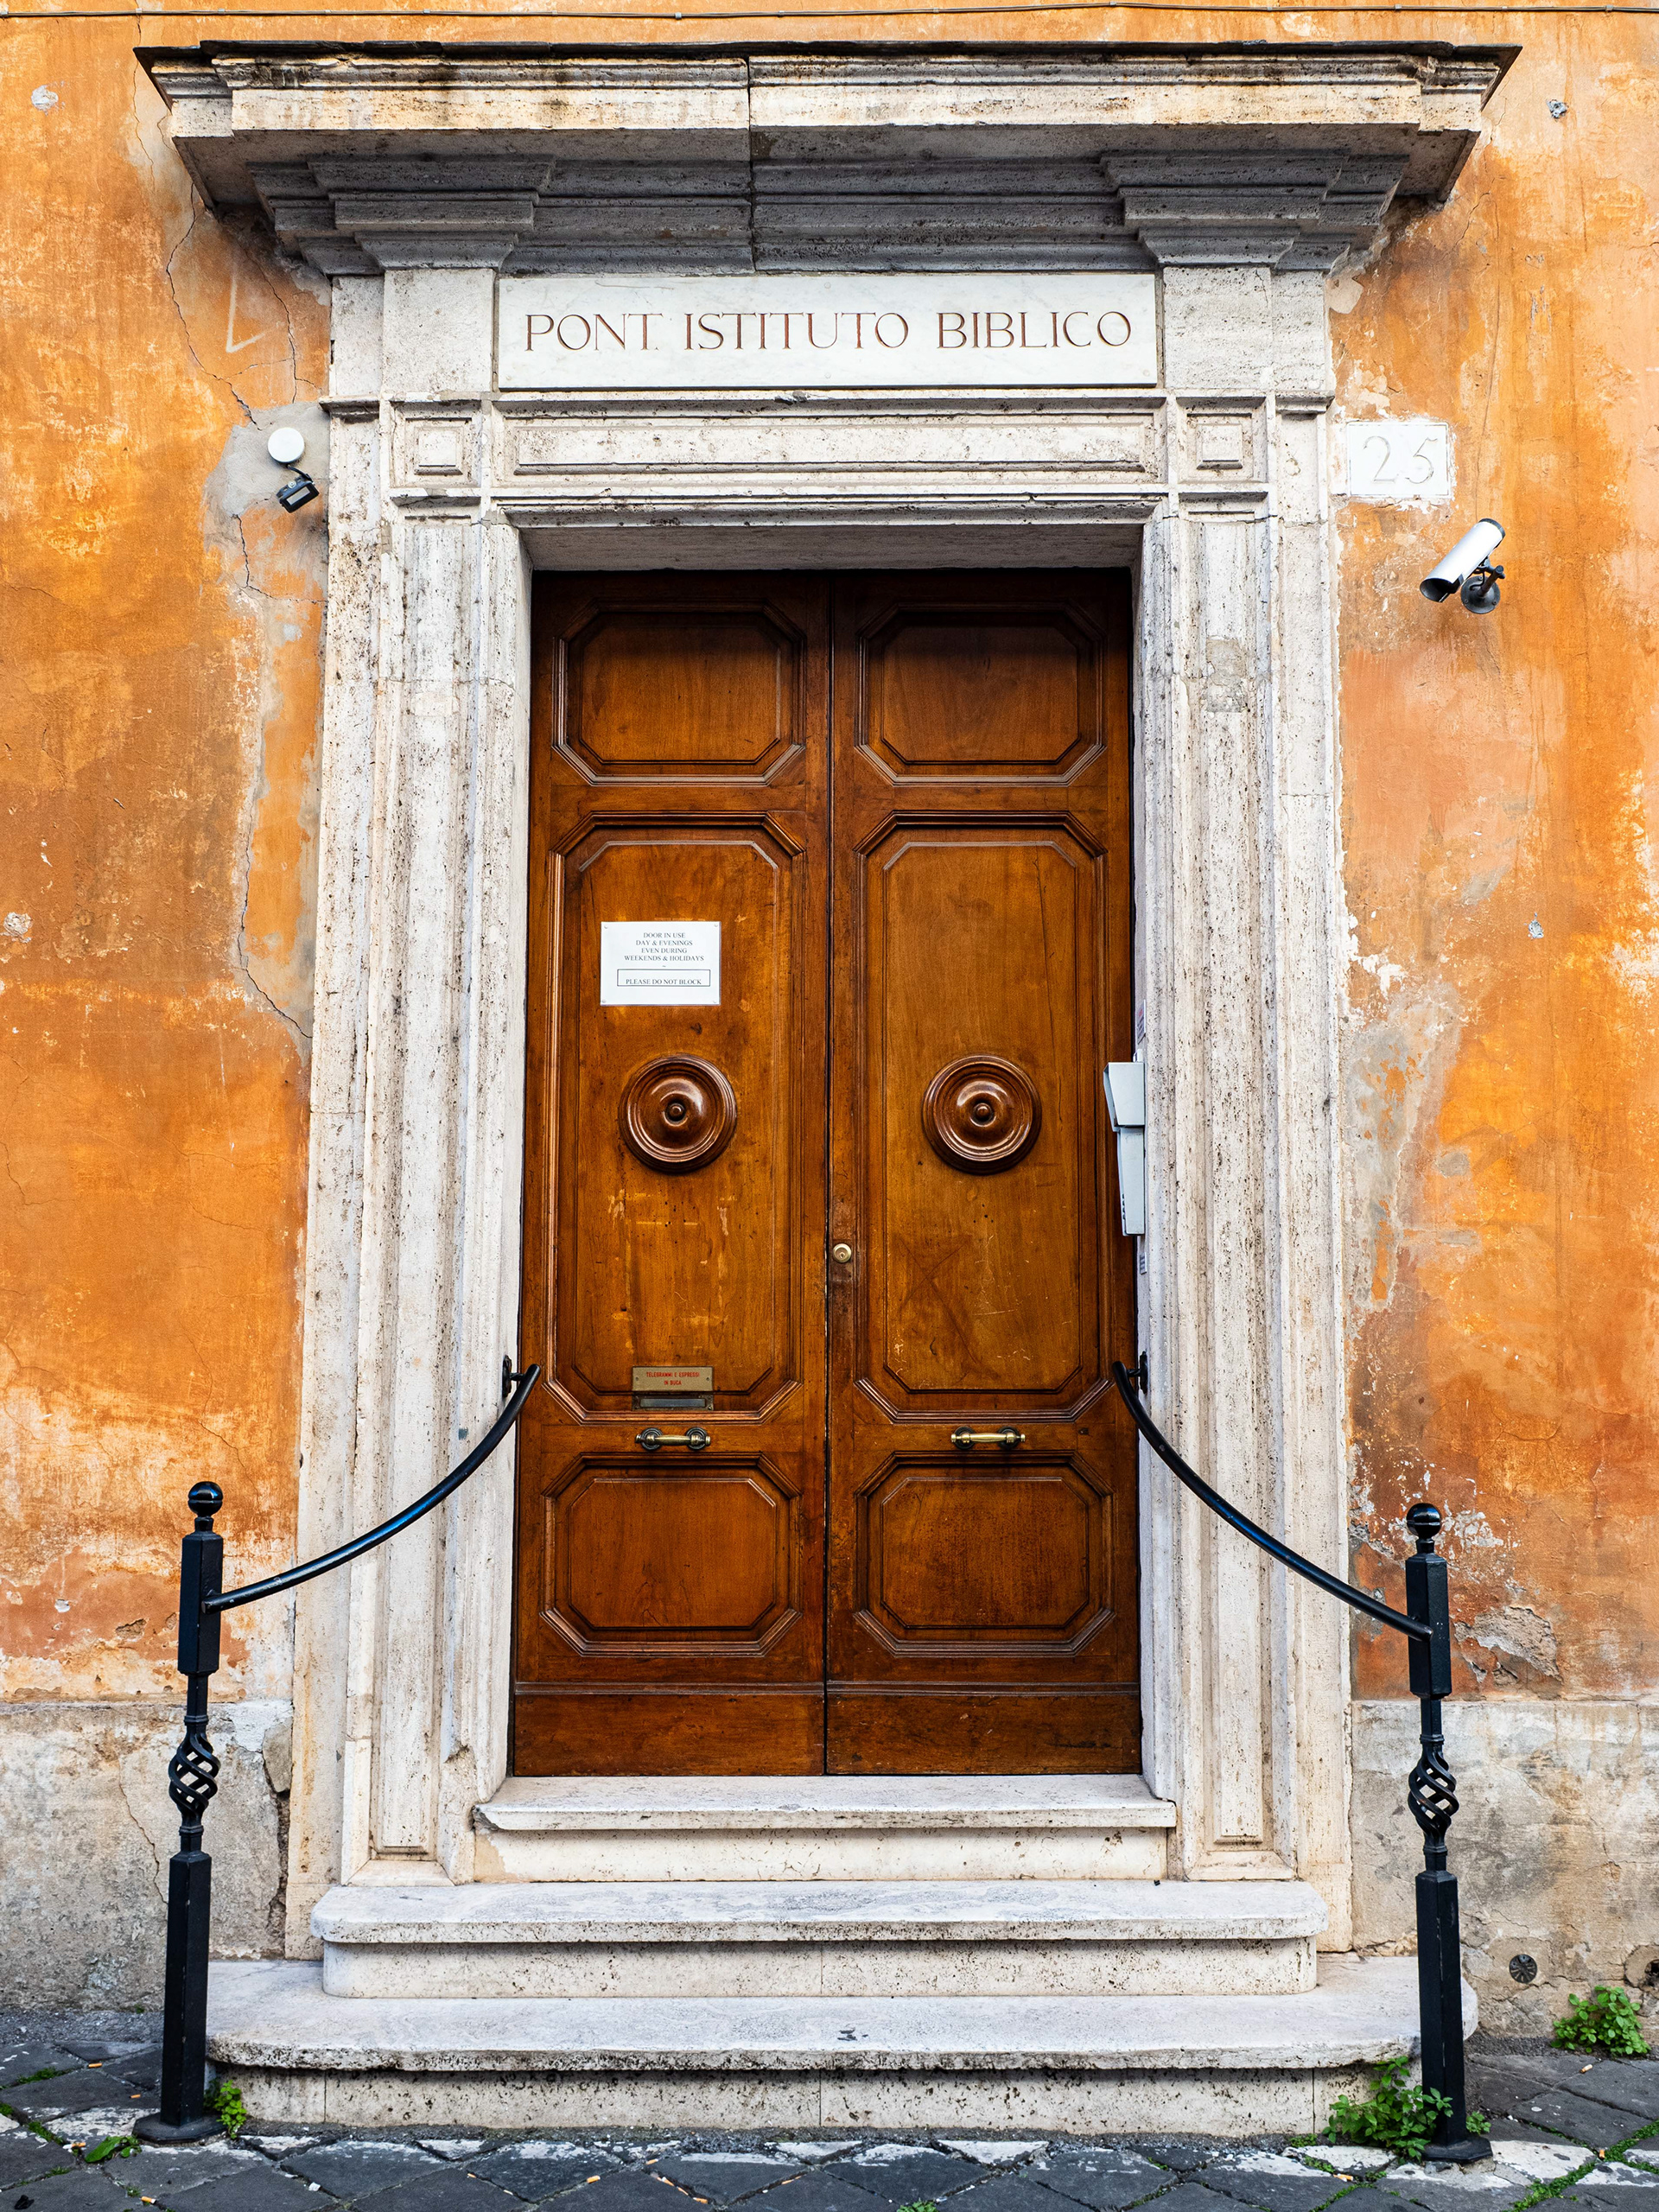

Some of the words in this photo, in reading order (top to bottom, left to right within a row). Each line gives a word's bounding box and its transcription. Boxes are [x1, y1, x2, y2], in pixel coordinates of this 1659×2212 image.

[524, 312, 664, 351] PONT.
[684, 311, 909, 350] ISTITUTO
[937, 310, 1131, 349] BIBLICO
[1363, 435, 1439, 485] 25
